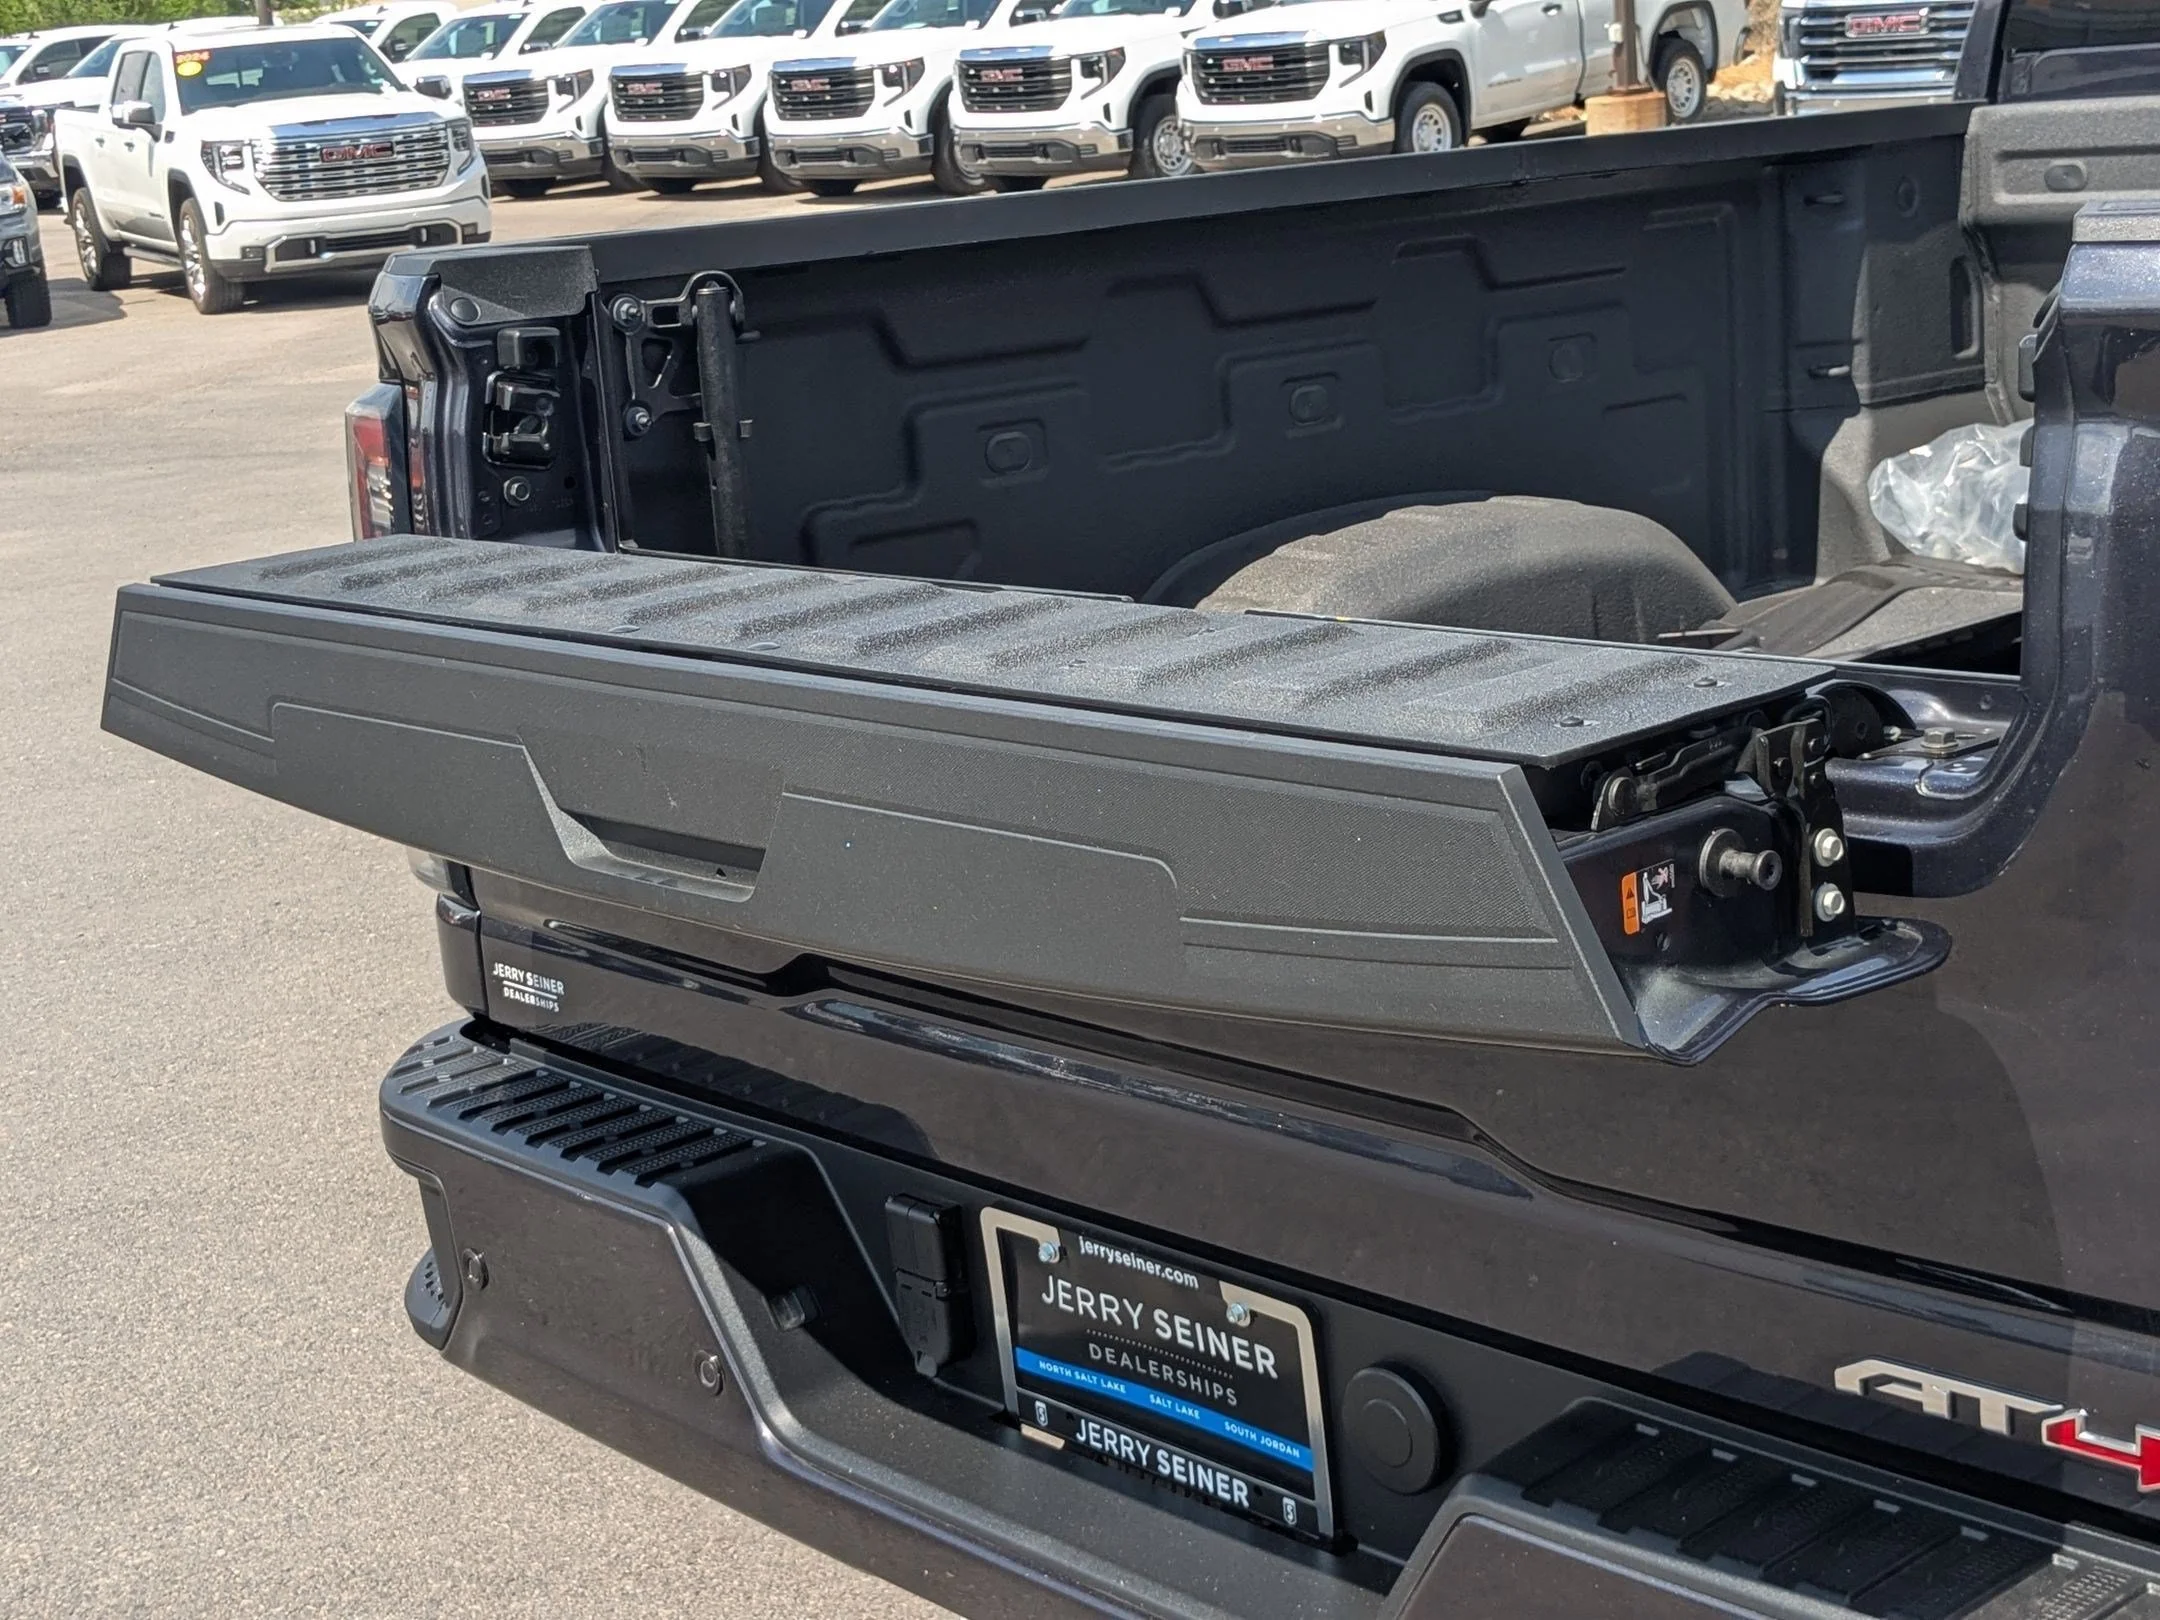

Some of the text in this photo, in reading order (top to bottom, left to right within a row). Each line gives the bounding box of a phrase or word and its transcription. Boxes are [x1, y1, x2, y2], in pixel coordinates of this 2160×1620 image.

[1850, 15, 1921, 34] GMC
[980, 68, 1024, 82] GMC
[1222, 56, 1274, 73] GMC
[790, 78, 831, 92] GMC
[321, 143, 393, 163] GMC
[493, 962, 565, 995] JERRY SEINER
[503, 987, 560, 1012] DEALERSHIPS
[1079, 1236, 1200, 1290] jerryseiner.com
[1041, 1276, 1279, 1379] JERRY SEINER
[1038, 1360, 1127, 1394] NORTH SALT LAKE
[1088, 1343, 1238, 1407] DEALERSHIPS
[1149, 1394, 1201, 1420] SALT LAKE
[1224, 1422, 1301, 1459] SOUTH JORDAN
[1833, 1359, 2160, 1493] AT4
[1075, 1419, 1250, 1508] JERRY SEINER
